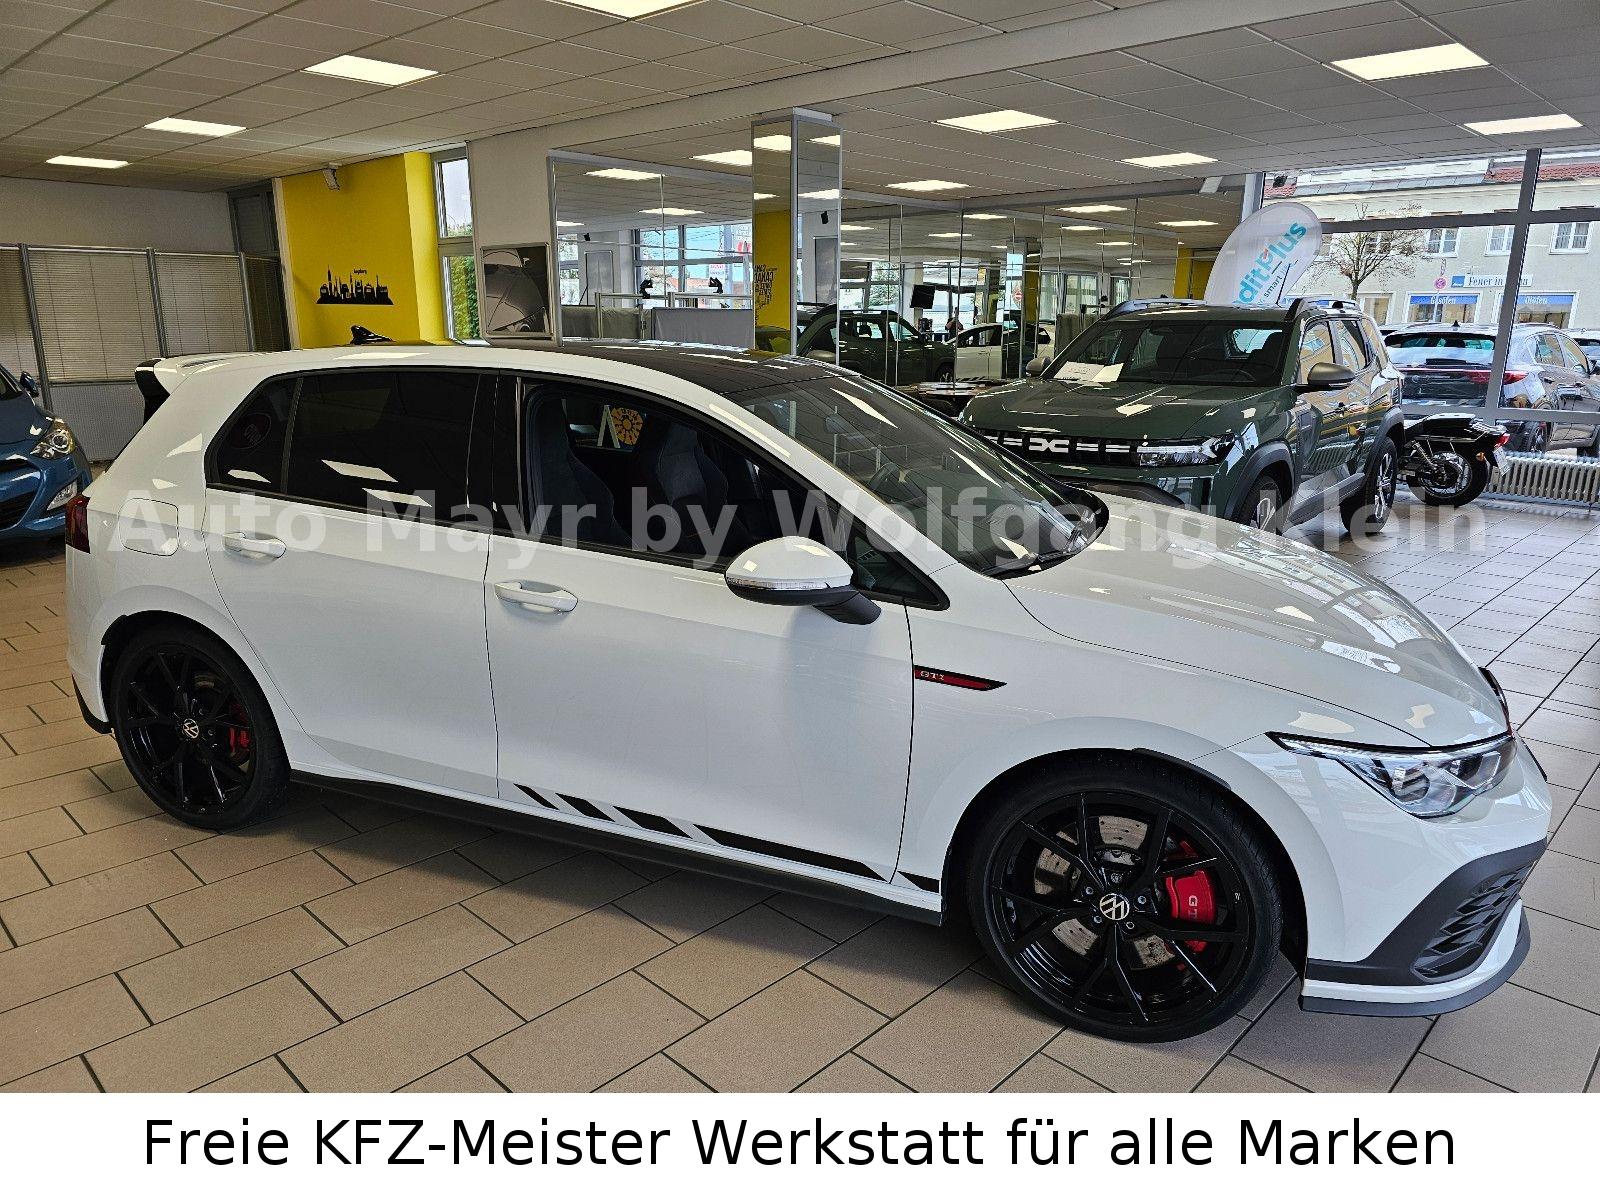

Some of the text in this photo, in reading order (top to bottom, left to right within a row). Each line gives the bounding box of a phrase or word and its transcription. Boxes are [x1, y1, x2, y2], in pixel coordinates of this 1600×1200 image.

[1234, 222, 1307, 304] ditplus
[1263, 275, 1283, 298] smart
[920, 670, 945, 681] GTI
